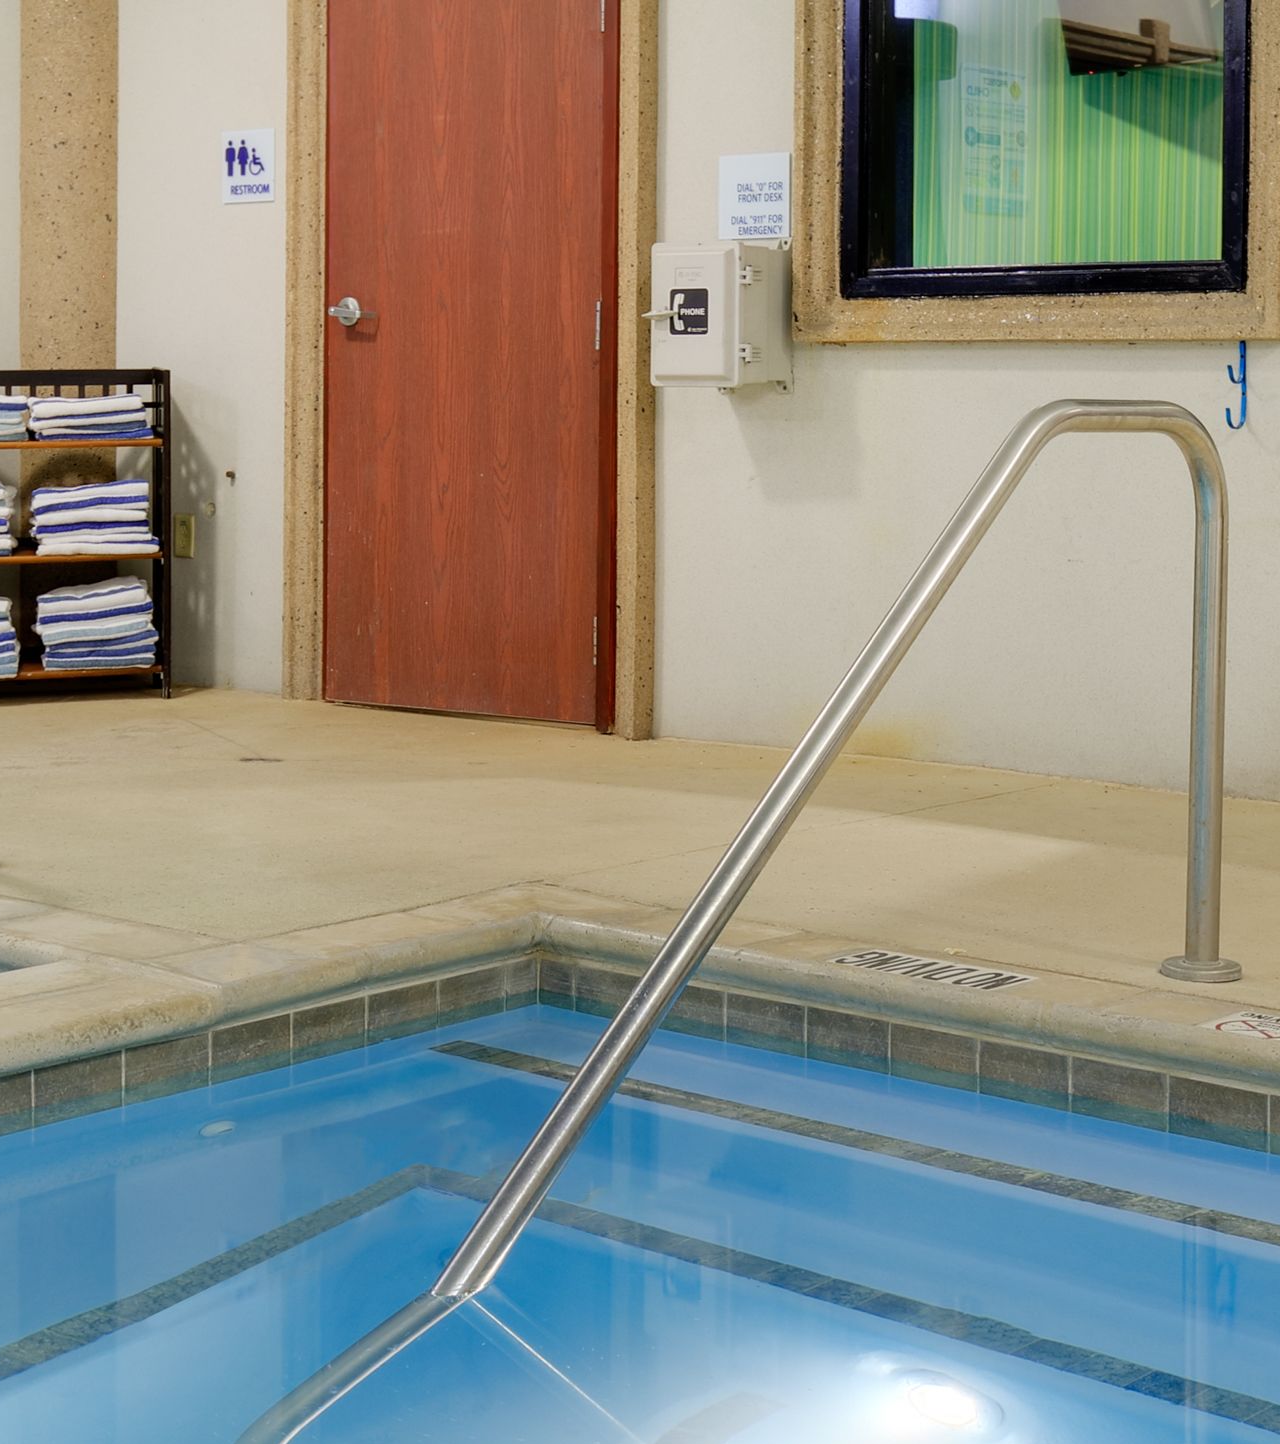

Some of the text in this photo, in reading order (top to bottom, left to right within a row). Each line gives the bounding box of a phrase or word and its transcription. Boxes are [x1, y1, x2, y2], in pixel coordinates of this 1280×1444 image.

[230, 183, 270, 195] RESTROOM
[737, 183, 754, 193] DIAL
[768, 181, 783, 191] FOR
[738, 192, 783, 203] FRONT DESK
[730, 215, 748, 225] DIAL
[768, 214, 783, 223] FOR
[738, 225, 783, 235] EMERGENCY
[680, 307, 706, 316] PHONE
[835, 951, 1029, 990] NO DIVING
